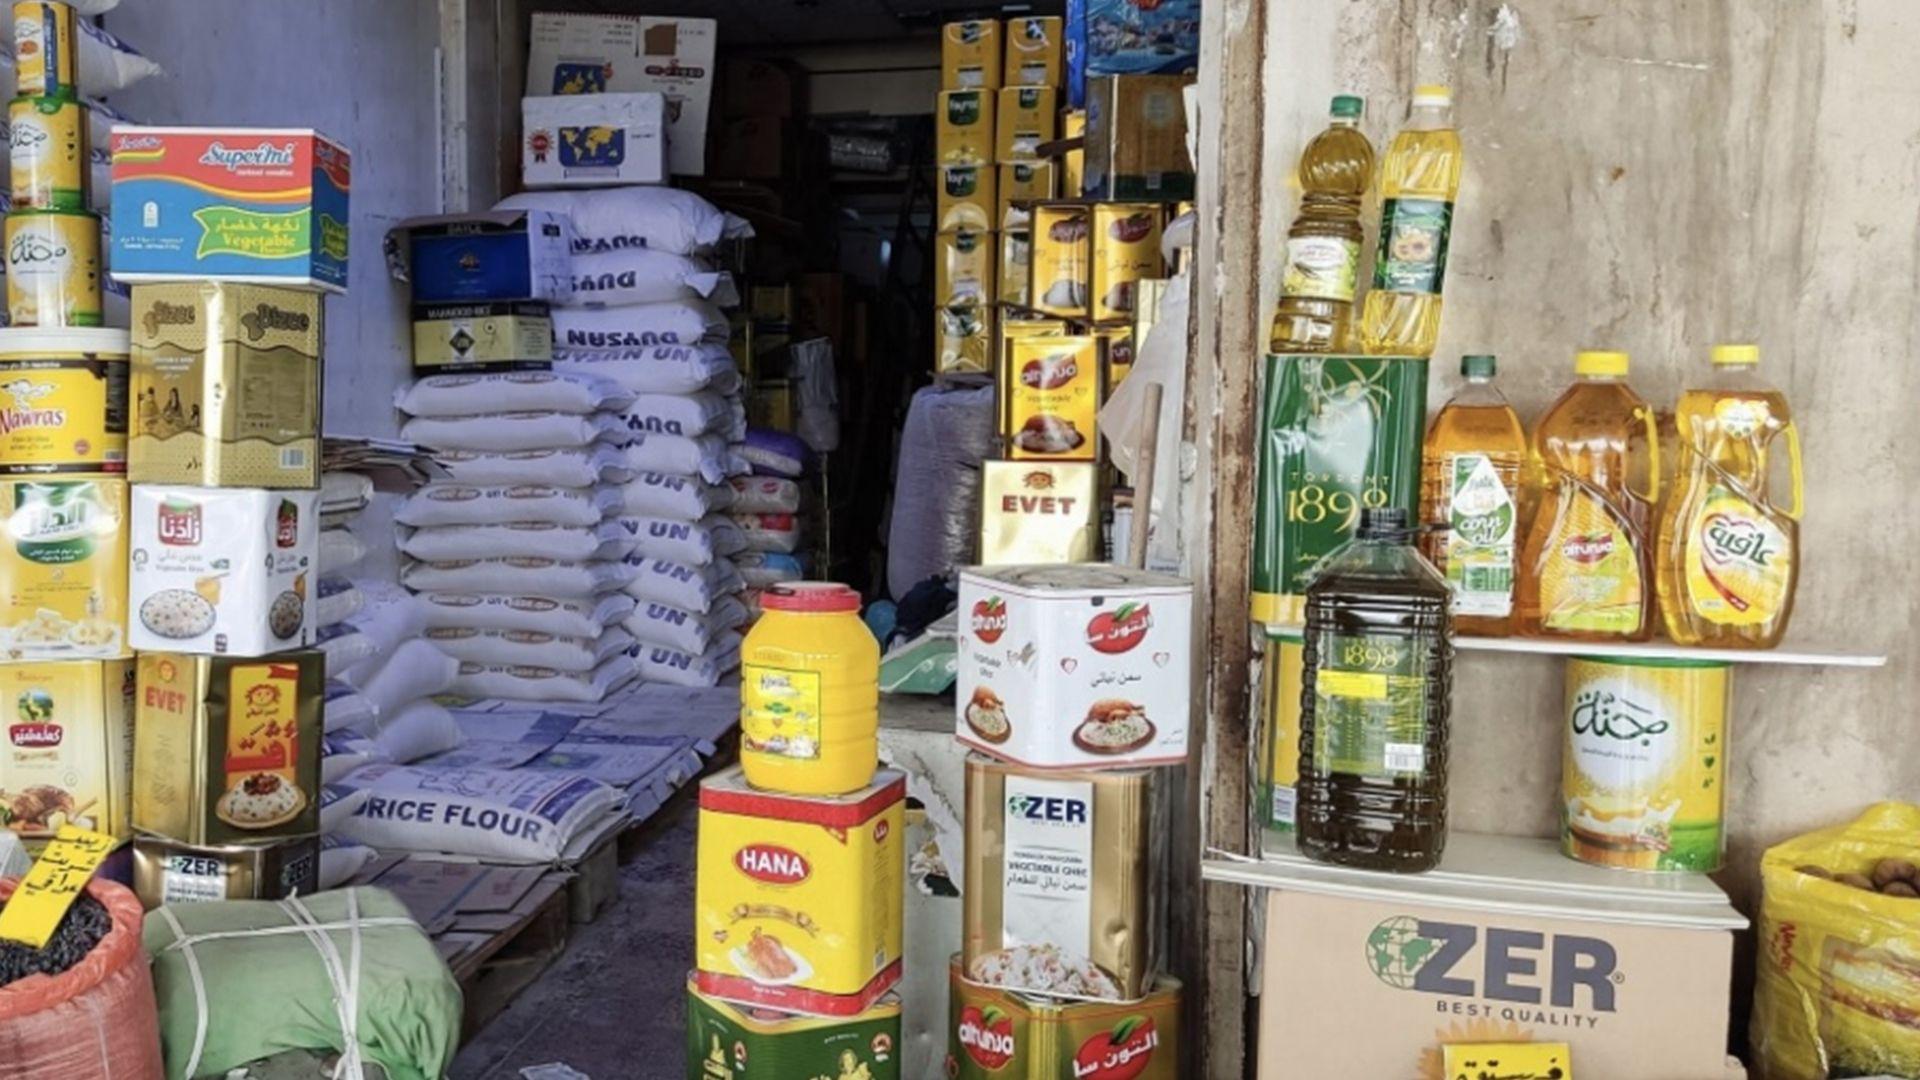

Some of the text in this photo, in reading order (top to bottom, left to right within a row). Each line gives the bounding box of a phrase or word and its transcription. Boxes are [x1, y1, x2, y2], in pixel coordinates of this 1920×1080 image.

[1001, 494, 1076, 515] EVET
[649, 521, 691, 540] UN
[1708, 520, 1775, 566] عافية
[652, 561, 695, 583] UN
[646, 603, 688, 626] UN
[650, 647, 692, 670] UN
[1344, 646, 1398, 671] 1898
[146, 685, 187, 715] EVET
[366, 797, 542, 843] RICE FLOUR
[1024, 795, 1087, 824] ZER
[180, 857, 220, 877] ZER
[742, 849, 805, 878] HANA
[1414, 920, 1616, 1013] ZER
[1437, 1000, 1599, 1029] BEST QUALITY
